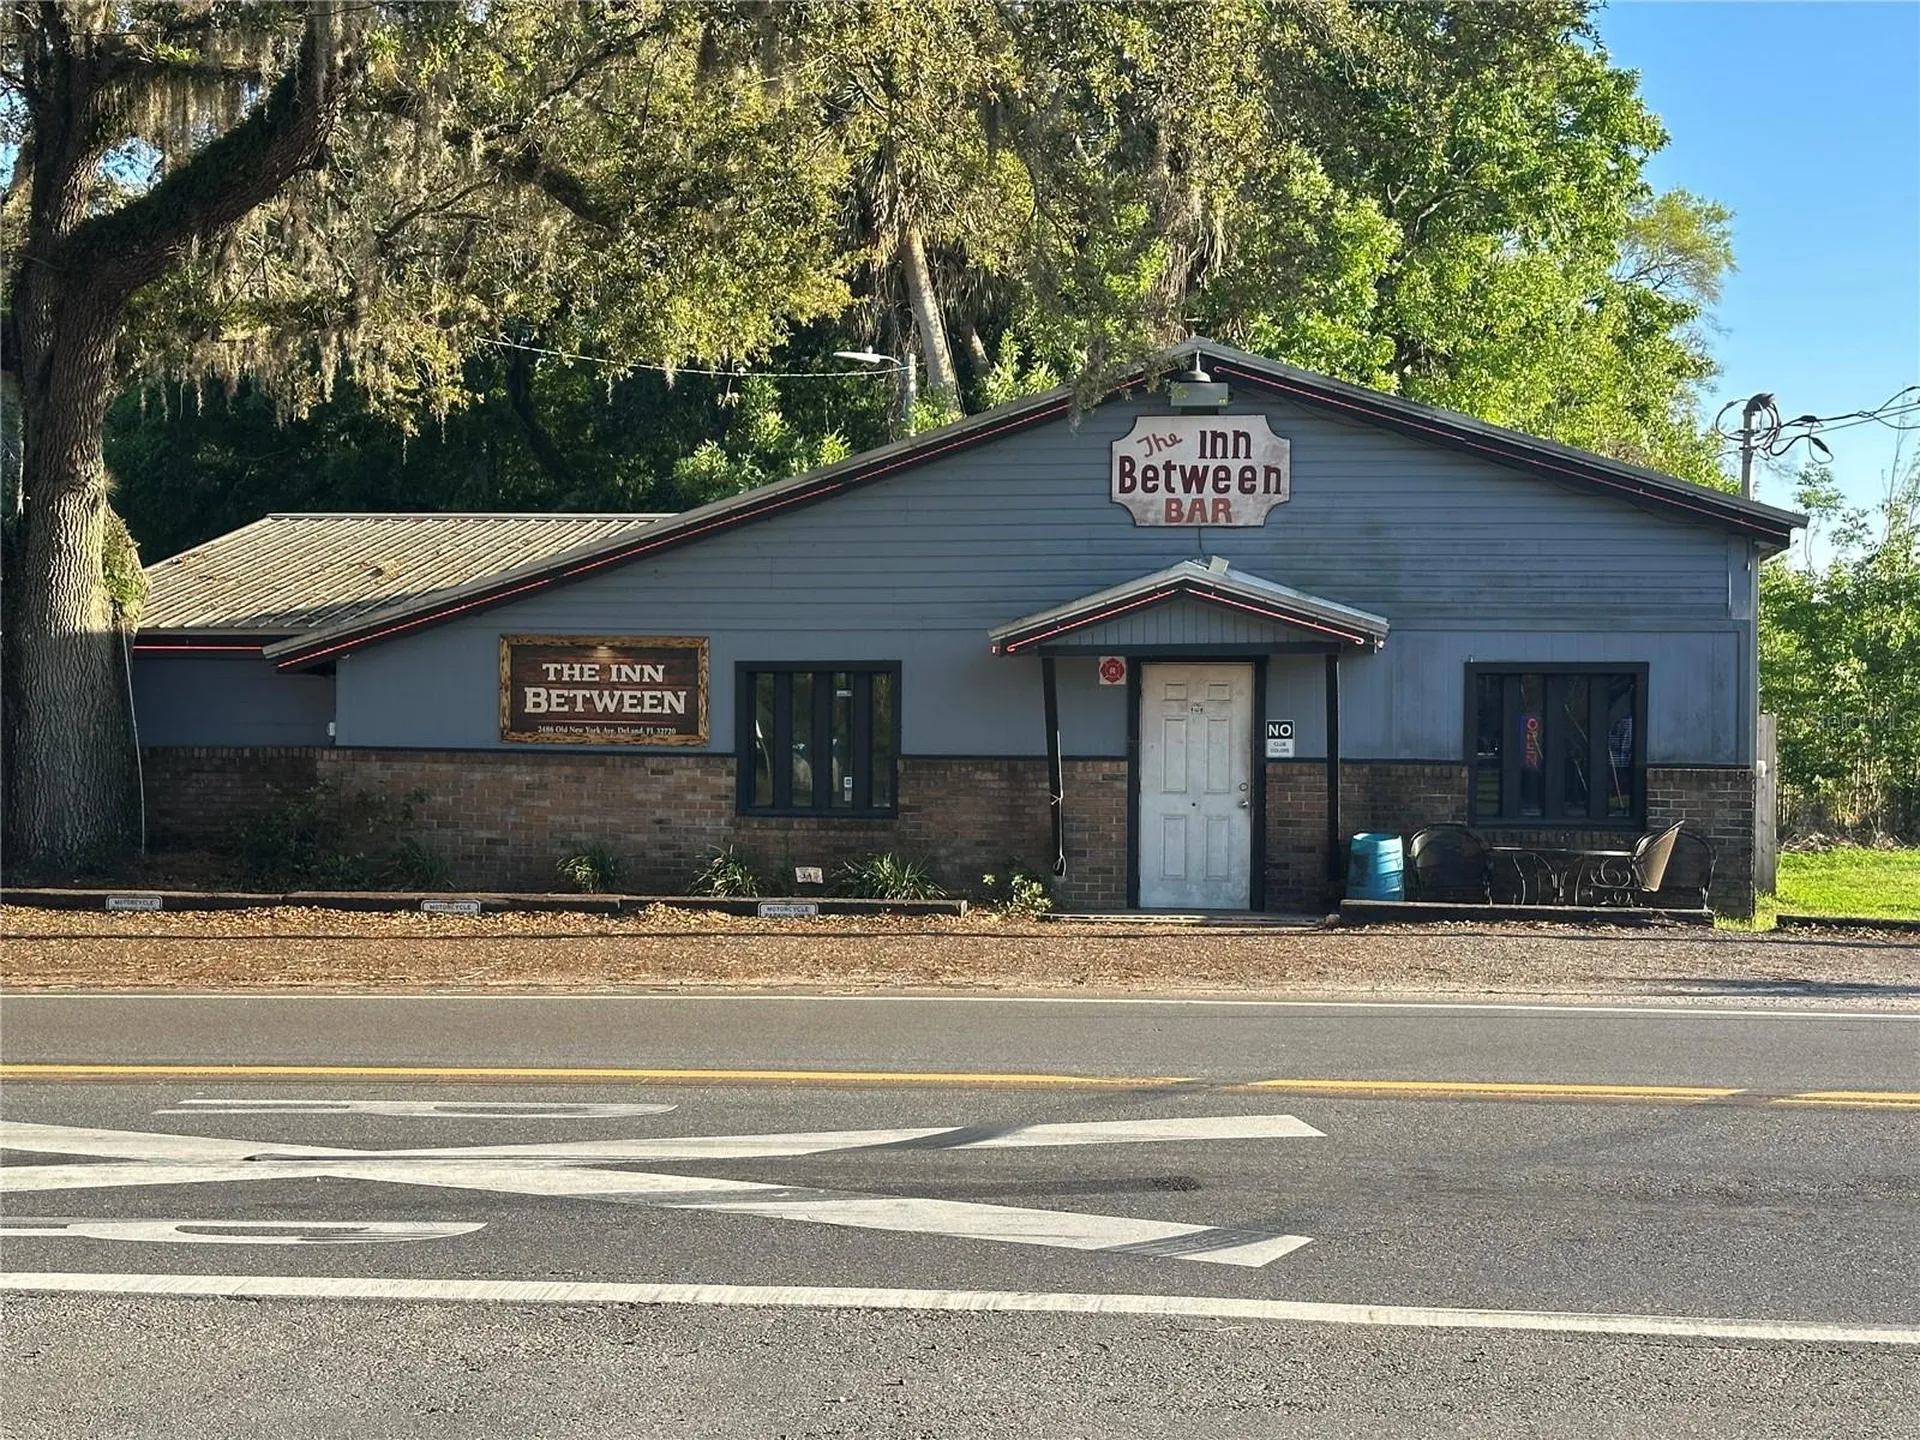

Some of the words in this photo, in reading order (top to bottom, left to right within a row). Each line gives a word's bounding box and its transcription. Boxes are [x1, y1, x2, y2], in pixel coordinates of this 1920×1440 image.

[1137, 432, 1183, 458] The
[1118, 455, 1282, 495] Between
[1164, 498, 1233, 524] BAR
[541, 663, 600, 682] THE
[609, 664, 665, 683] INN
[523, 687, 687, 715] BETWEEN
[555, 725, 568, 733] Old
[569, 725, 584, 733] New
[1268, 724, 1292, 737] NO
